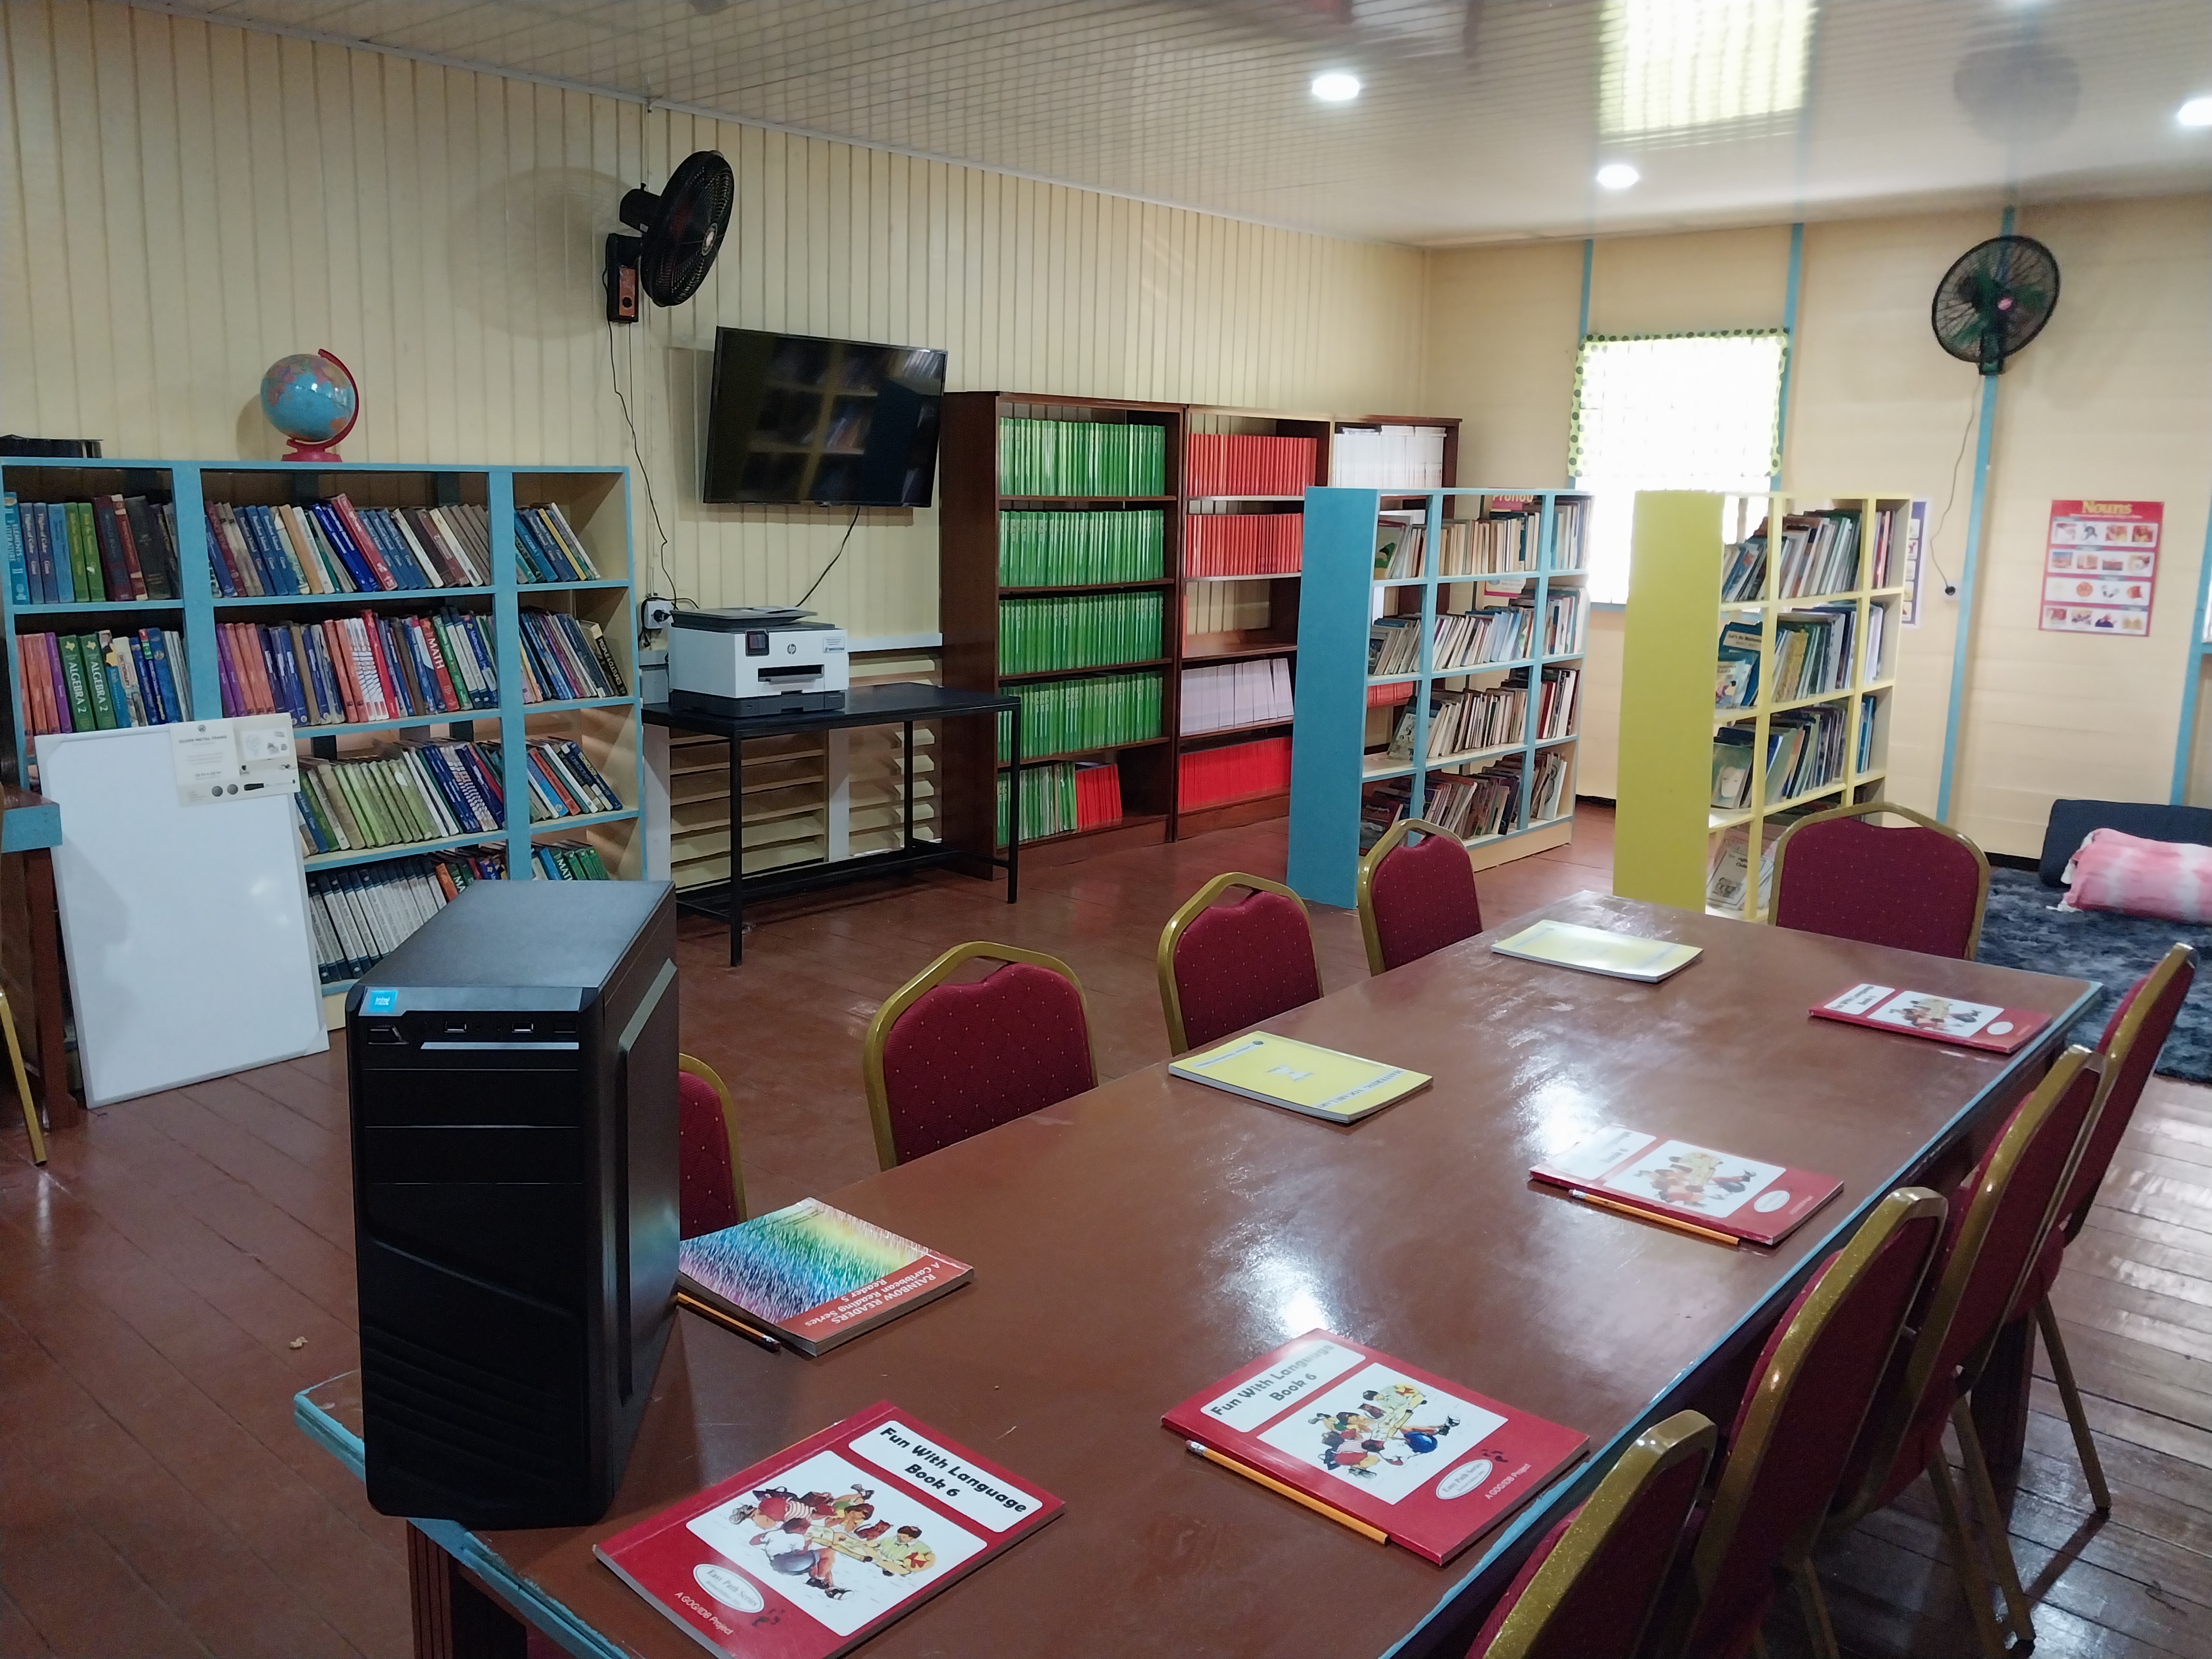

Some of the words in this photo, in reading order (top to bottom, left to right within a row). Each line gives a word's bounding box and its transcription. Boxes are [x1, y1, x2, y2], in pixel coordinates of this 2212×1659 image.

[2081, 500, 2133, 515] Nouns
[427, 638, 446, 670] MATH
[470, 629, 484, 662] Mathematics
[598, 639, 610, 658] PEOPLE
[608, 661, 623, 686] CULTURES
[68, 661, 86, 705] ALGEBRA
[90, 661, 106, 704] ALGEBRA
[577, 751, 598, 777] TECHNOLOGY
[1363, 1069, 1406, 1089] MASTERING
[1315, 1089, 1364, 1109] VOCABULARY
[851, 1278, 888, 1298] Reader
[880, 1266, 933, 1294] Caribbean
[884, 1273, 937, 1302] RAINBOW
[831, 1298, 884, 1325] READERS
[837, 1290, 883, 1313] Reading
[840, 1294, 850, 1302] 5
[804, 1308, 839, 1327] Series
[1210, 1398, 1243, 1416] Fun
[1237, 1379, 1275, 1398] With
[1269, 1344, 1335, 1380] Language
[1268, 1380, 1308, 1401] Book
[1304, 1373, 1317, 1381] 6
[879, 1427, 911, 1449] Fun
[911, 1444, 949, 1470] With
[947, 1465, 1027, 1513] Language
[904, 1463, 947, 1490] Book
[946, 1488, 961, 1497] 6
[1455, 1472, 1470, 1483] Path
[1467, 1462, 1484, 1474] Series
[1511, 1463, 1532, 1478] Project
[722, 1579, 740, 1593] Path
[737, 1590, 758, 1607] Series
[708, 1616, 735, 1636] Project
